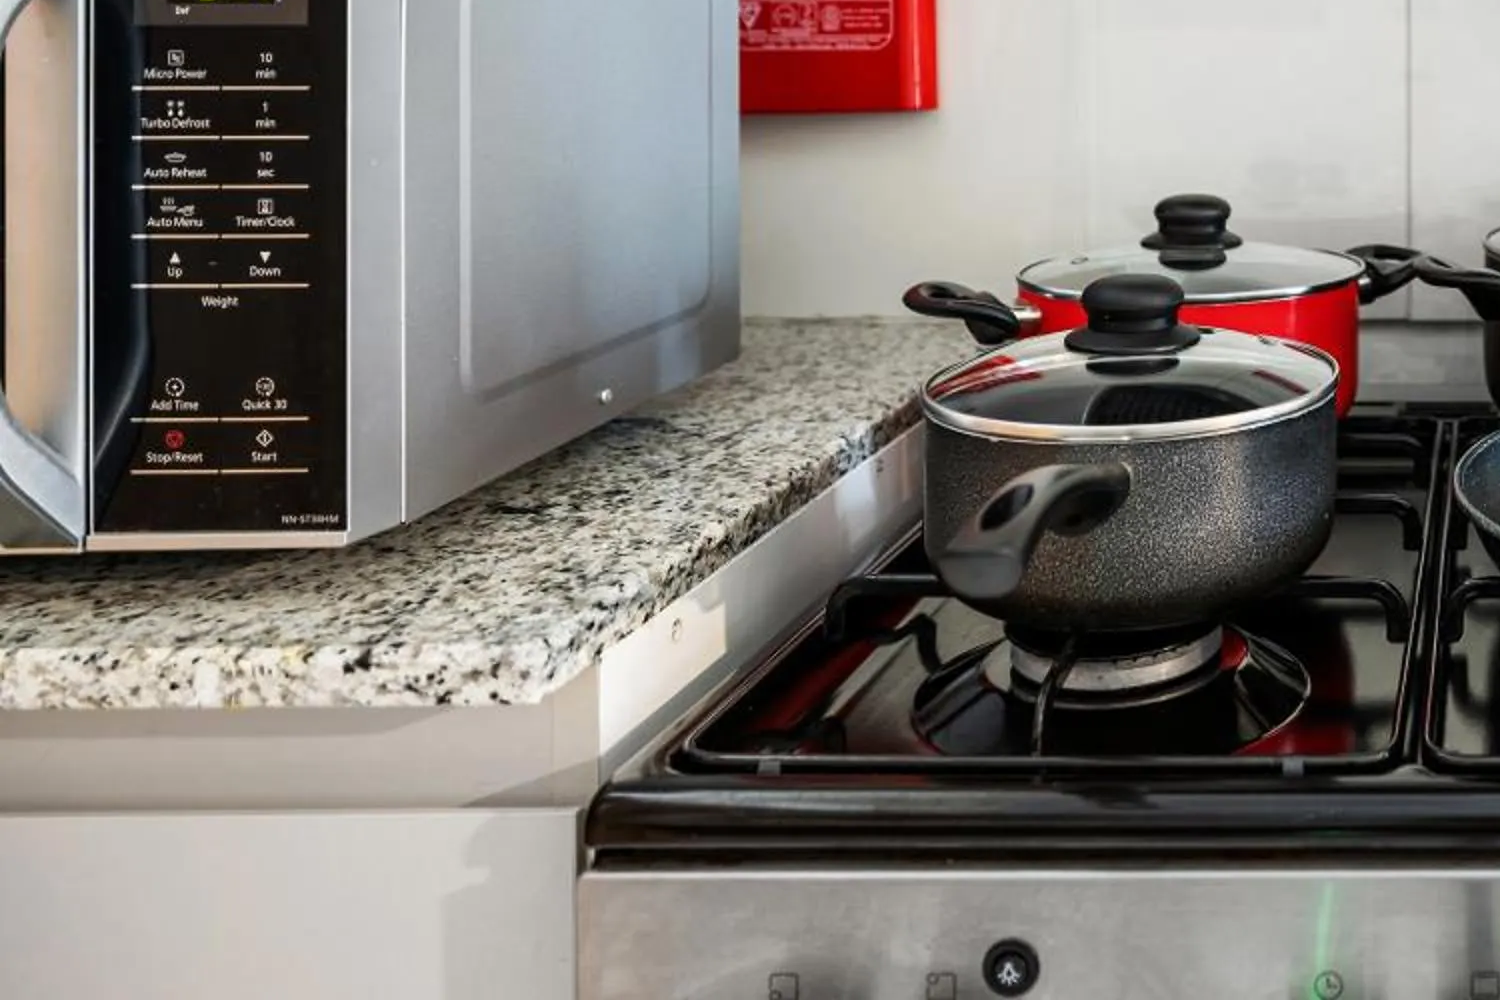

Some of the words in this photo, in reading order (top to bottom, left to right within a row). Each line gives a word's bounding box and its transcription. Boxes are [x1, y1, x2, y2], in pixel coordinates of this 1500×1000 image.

[259, 52, 273, 63] 10
[143, 68, 174, 79] Micro
[175, 68, 207, 79] Power
[255, 68, 277, 79] min
[141, 117, 171, 128] Turbo
[172, 117, 211, 128] Defrost
[255, 118, 277, 128] min
[259, 152, 273, 162] 10
[144, 168, 169, 178] Auto
[171, 167, 207, 178] Reheat
[257, 168, 275, 178] sec
[147, 217, 172, 227] Auto
[173, 217, 203, 227] Menu
[236, 216, 295, 227] Timer/Clock
[167, 266, 183, 279] Up
[249, 266, 281, 276] Down
[201, 296, 239, 309] Weight
[150, 400, 173, 410] Add
[174, 400, 199, 411] Time
[242, 400, 272, 411] Quick
[273, 400, 288, 410] 30
[146, 451, 203, 464] Stop/Reset
[251, 451, 277, 462] Start
